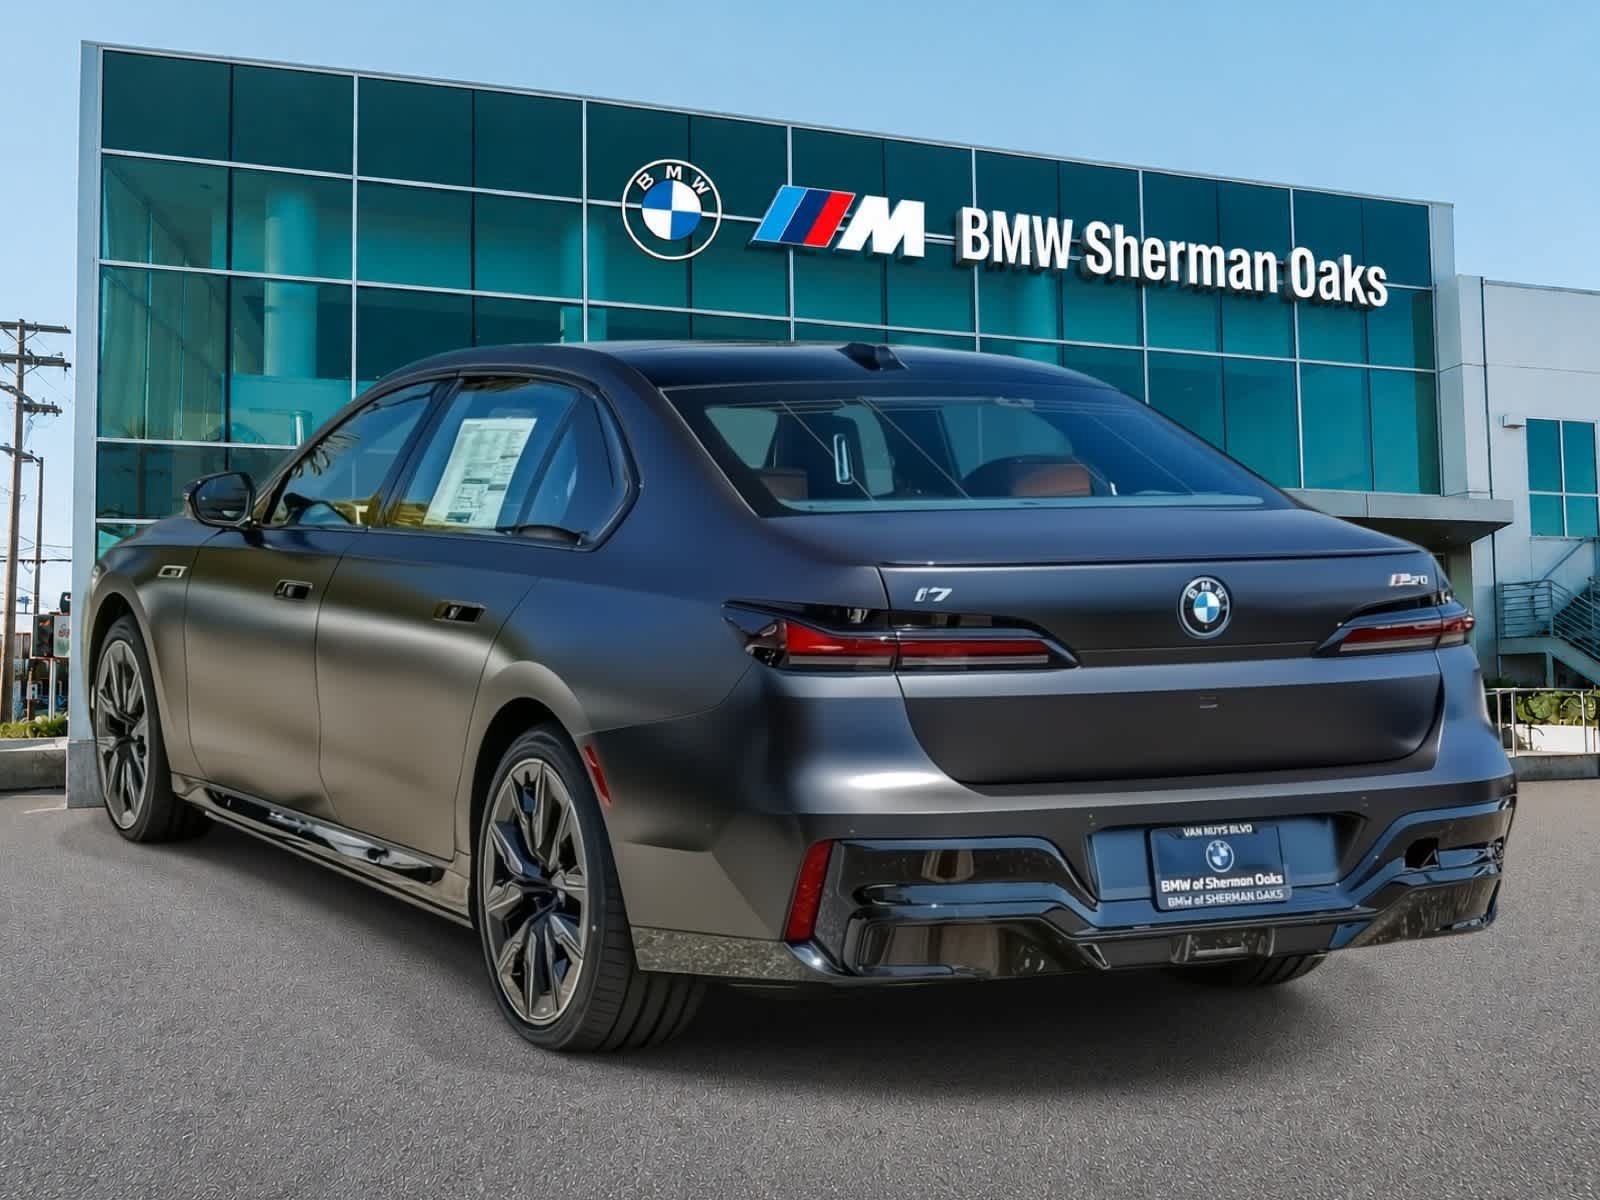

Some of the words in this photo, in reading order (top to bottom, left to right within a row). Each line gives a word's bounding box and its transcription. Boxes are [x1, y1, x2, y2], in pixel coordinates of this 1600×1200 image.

[636, 164, 711, 194] BMW
[959, 206, 1073, 270] BMW
[1085, 221, 1279, 293] Sherman
[1289, 246, 1389, 307] Oaks
[1183, 826, 1203, 838] VAN
[1229, 823, 1253, 835] BLVD
[1161, 879, 1191, 893] BMW
[1192, 877, 1204, 891] of
[1205, 875, 1254, 890] Sherman
[1255, 872, 1284, 886] Oaks
[1167, 895, 1193, 908] BMW
[1194, 893, 1204, 905] of
[1205, 890, 1255, 905] SHERMAN
[1256, 888, 1284, 902] OAKS
